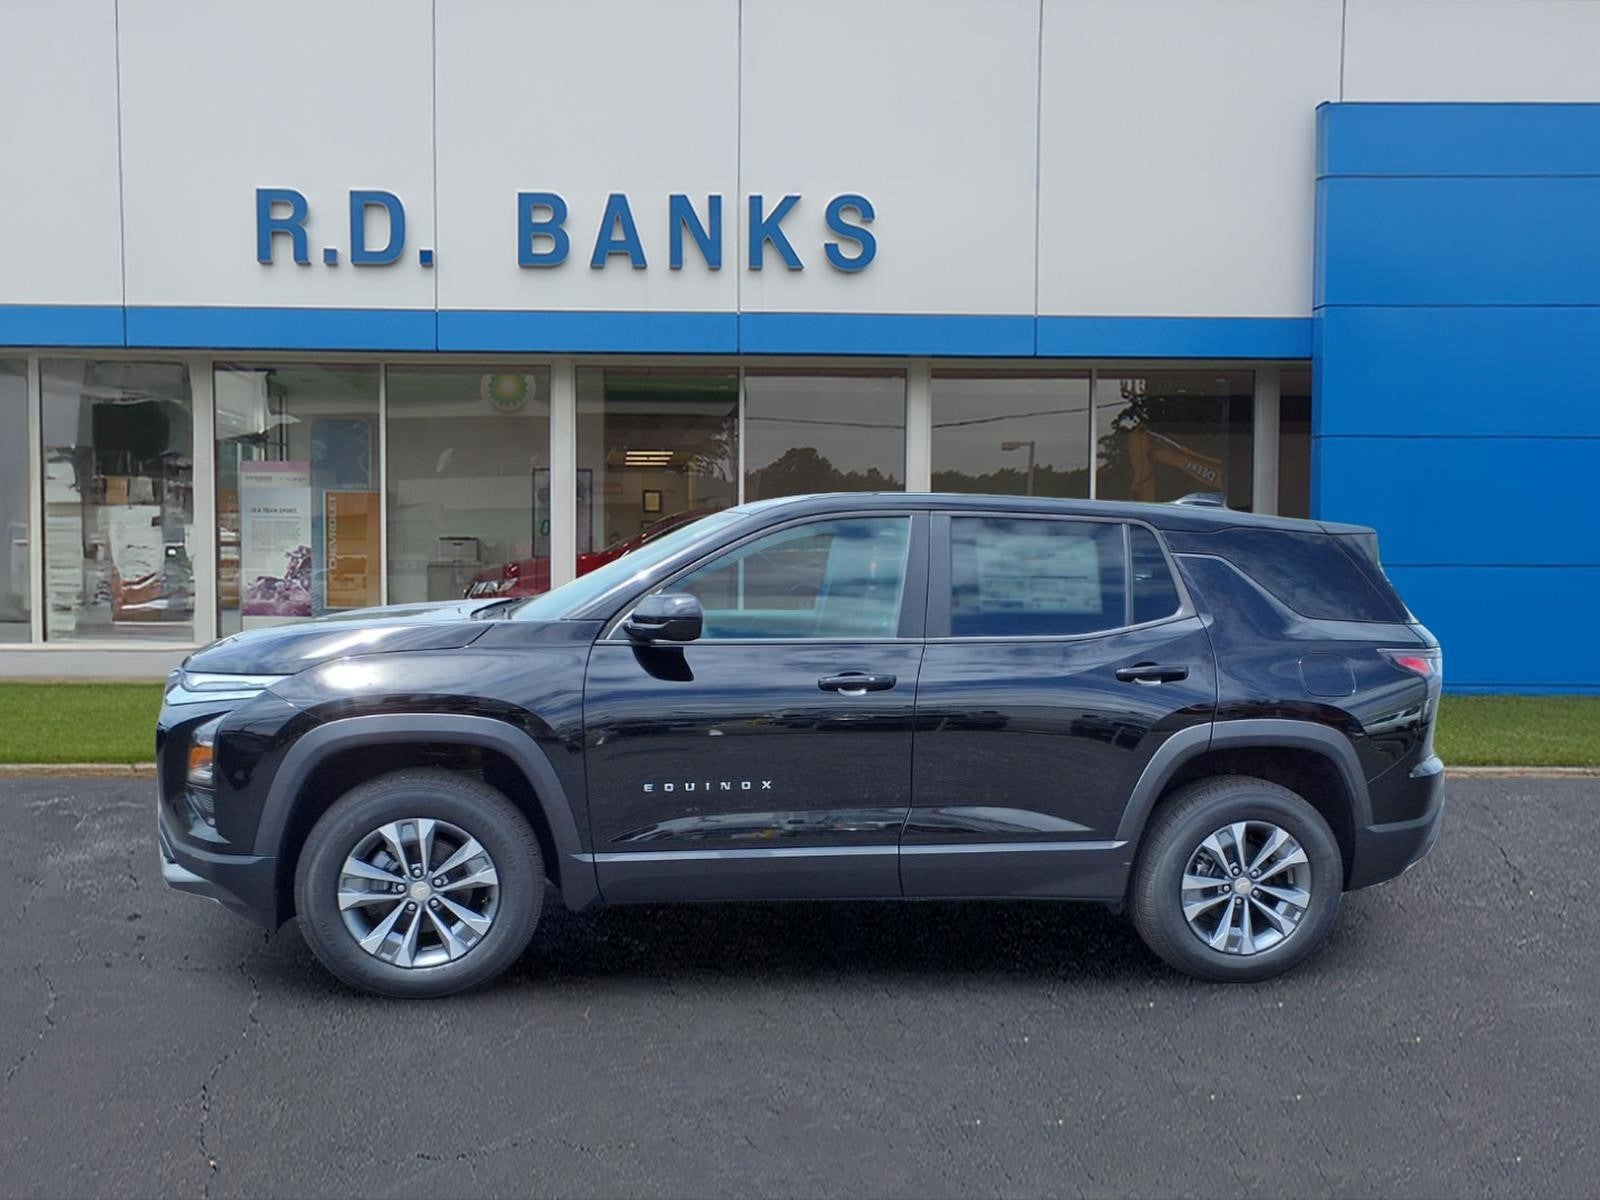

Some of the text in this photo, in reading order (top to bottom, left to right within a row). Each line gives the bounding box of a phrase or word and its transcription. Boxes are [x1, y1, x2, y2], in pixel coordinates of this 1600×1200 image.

[256, 188, 878, 272] R.D. BANKS
[643, 780, 772, 792] EQUINOX
